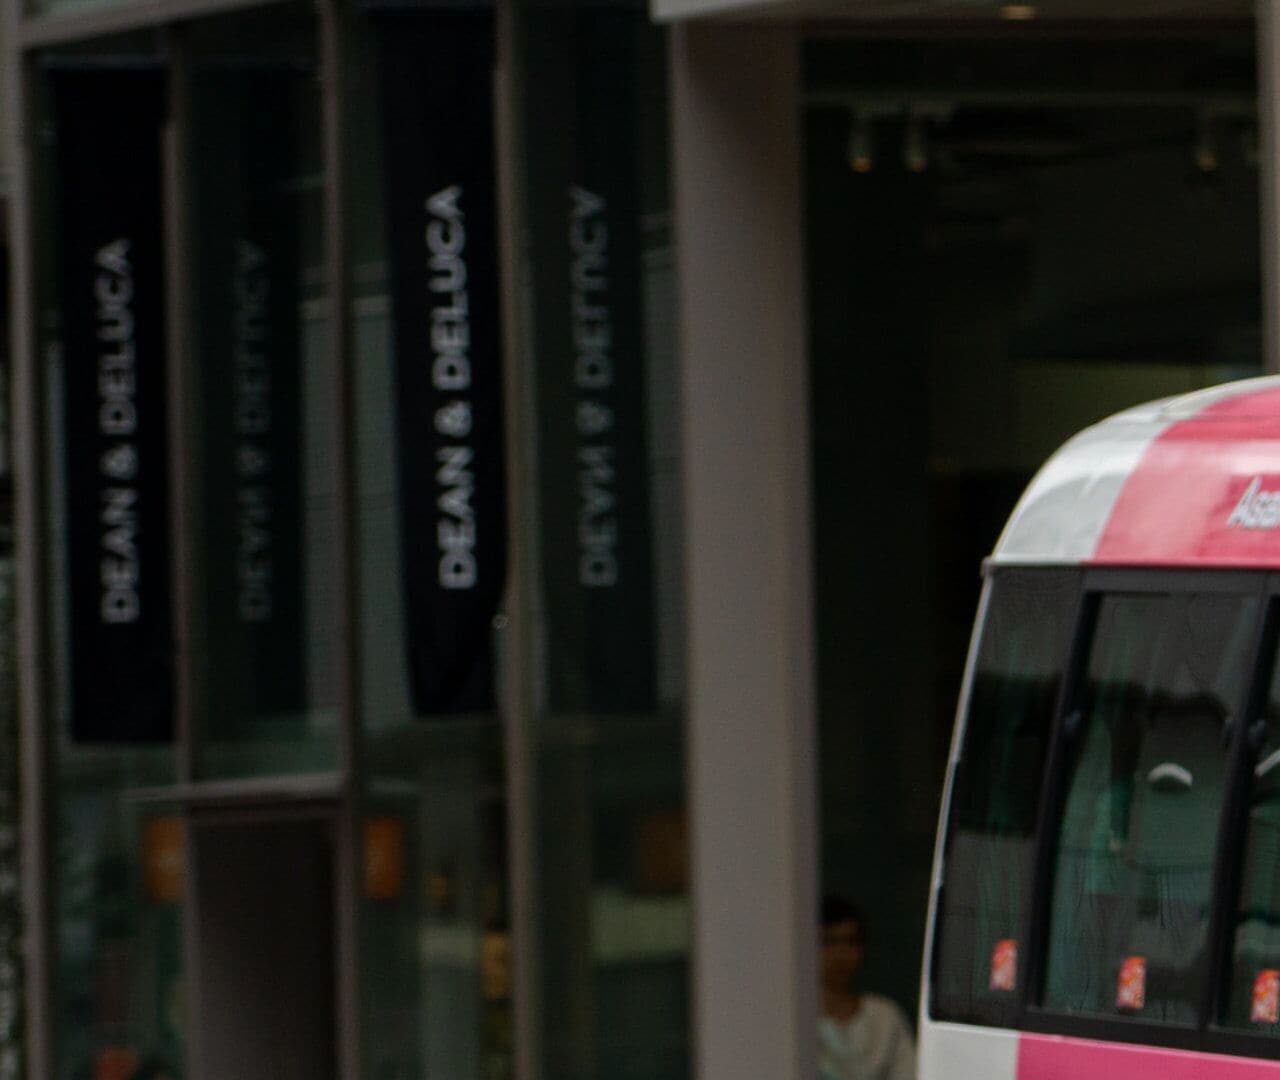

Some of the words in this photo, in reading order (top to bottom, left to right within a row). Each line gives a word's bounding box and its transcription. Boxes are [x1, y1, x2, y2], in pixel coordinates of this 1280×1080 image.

[94, 237, 136, 436] DELUCA
[426, 185, 472, 391] DELUCA
[100, 443, 138, 478] &
[434, 402, 472, 438] &
[101, 488, 139, 624] DEAN
[437, 446, 478, 590] DEAN
